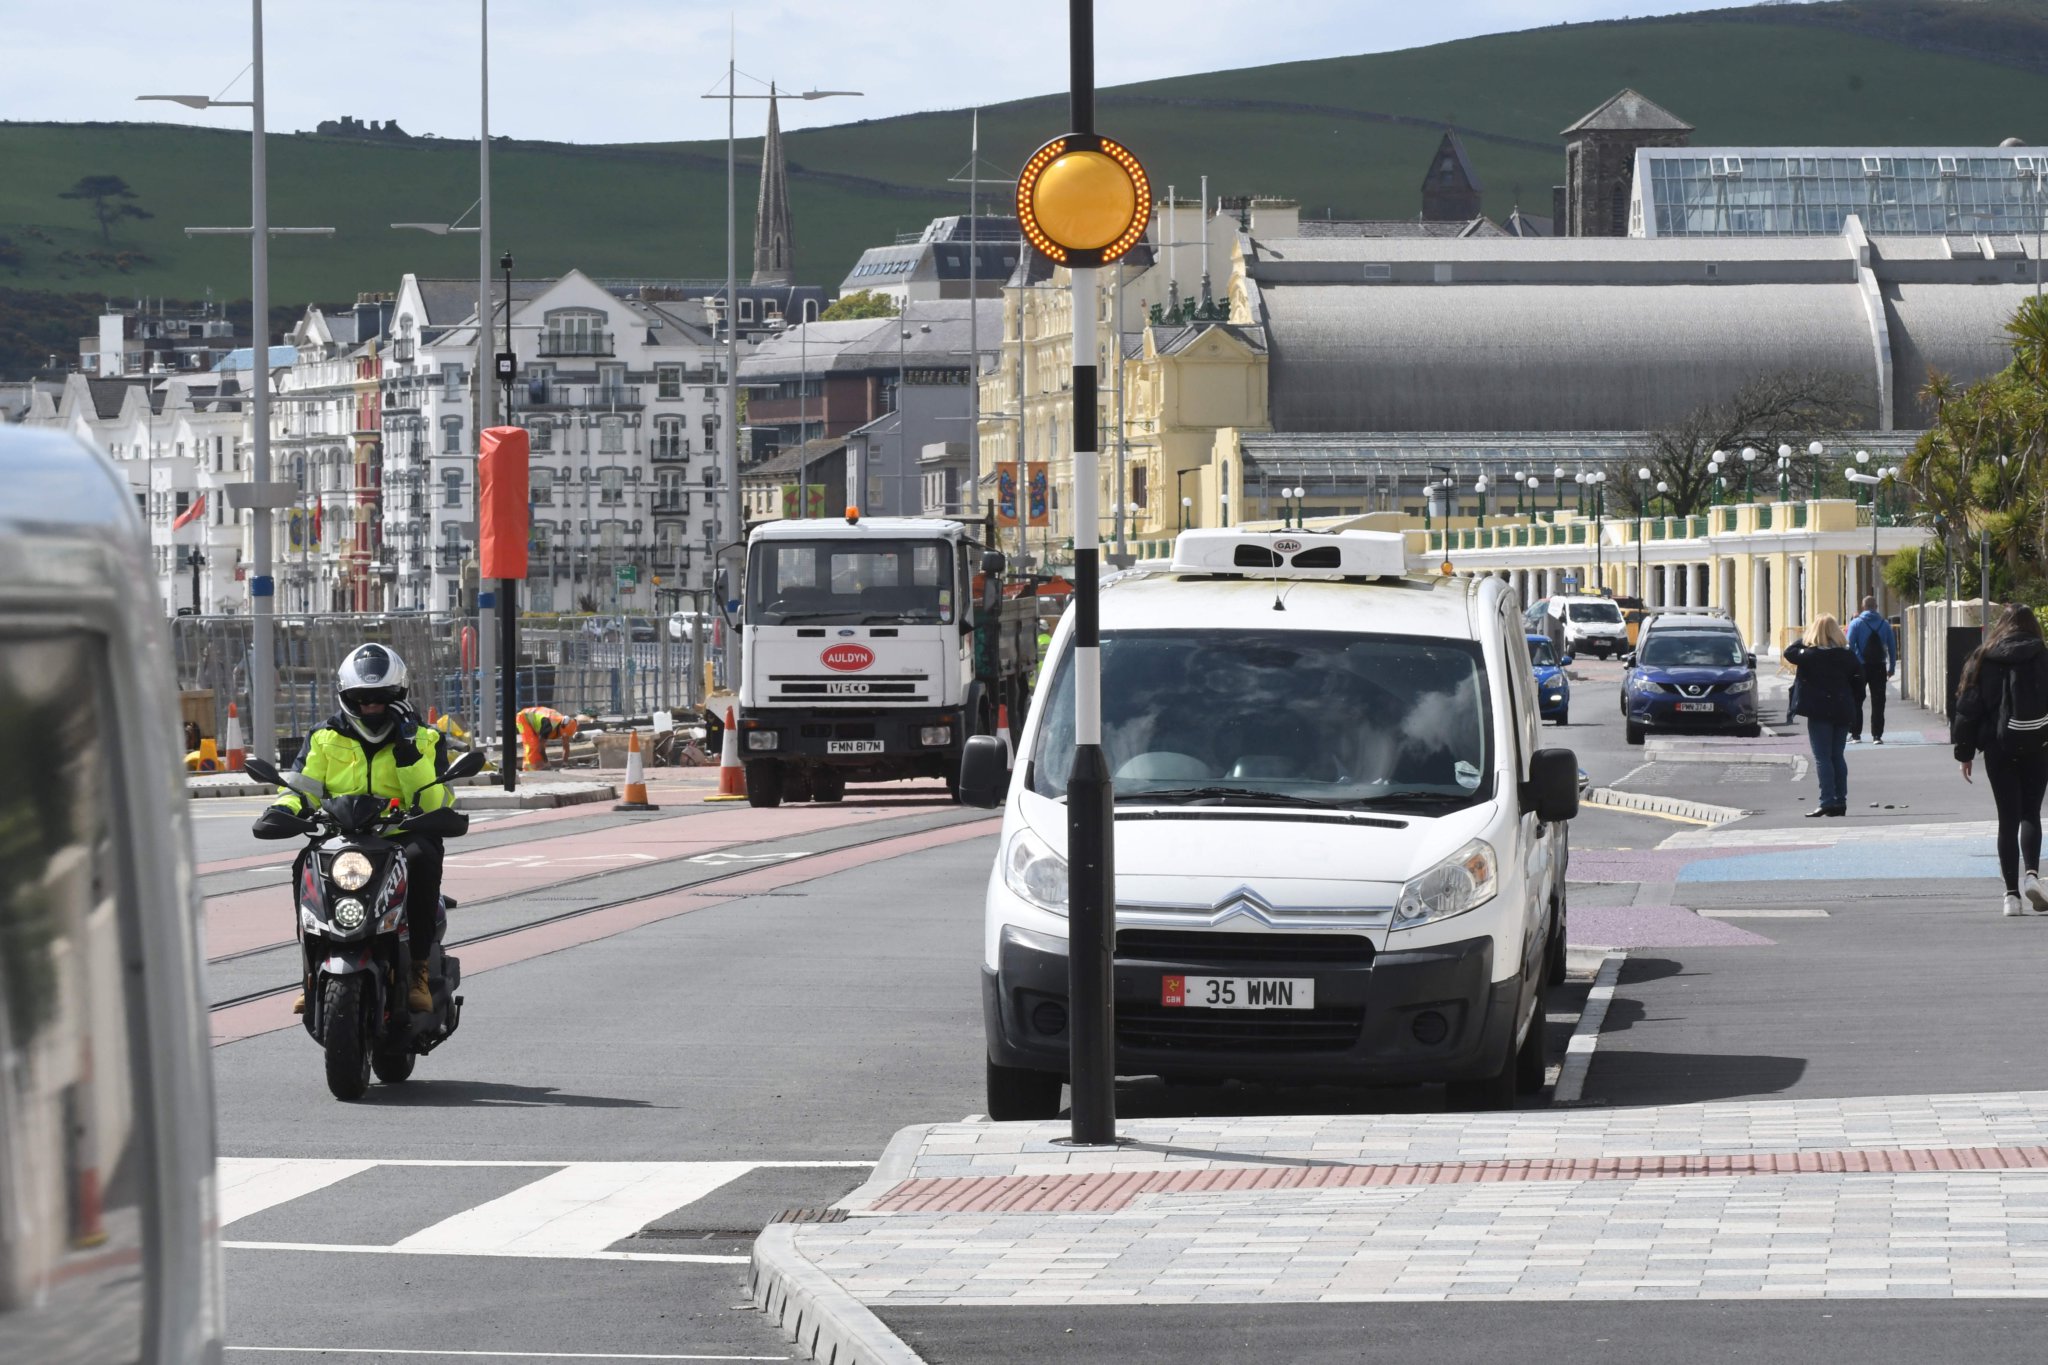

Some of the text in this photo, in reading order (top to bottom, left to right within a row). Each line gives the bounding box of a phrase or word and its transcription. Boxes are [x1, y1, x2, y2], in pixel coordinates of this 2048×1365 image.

[827, 653, 868, 663] AULDYN
[826, 683, 870, 694] IVECO
[831, 742, 881, 752] FMN 817M
[1206, 980, 1293, 1005] 35 WMN
